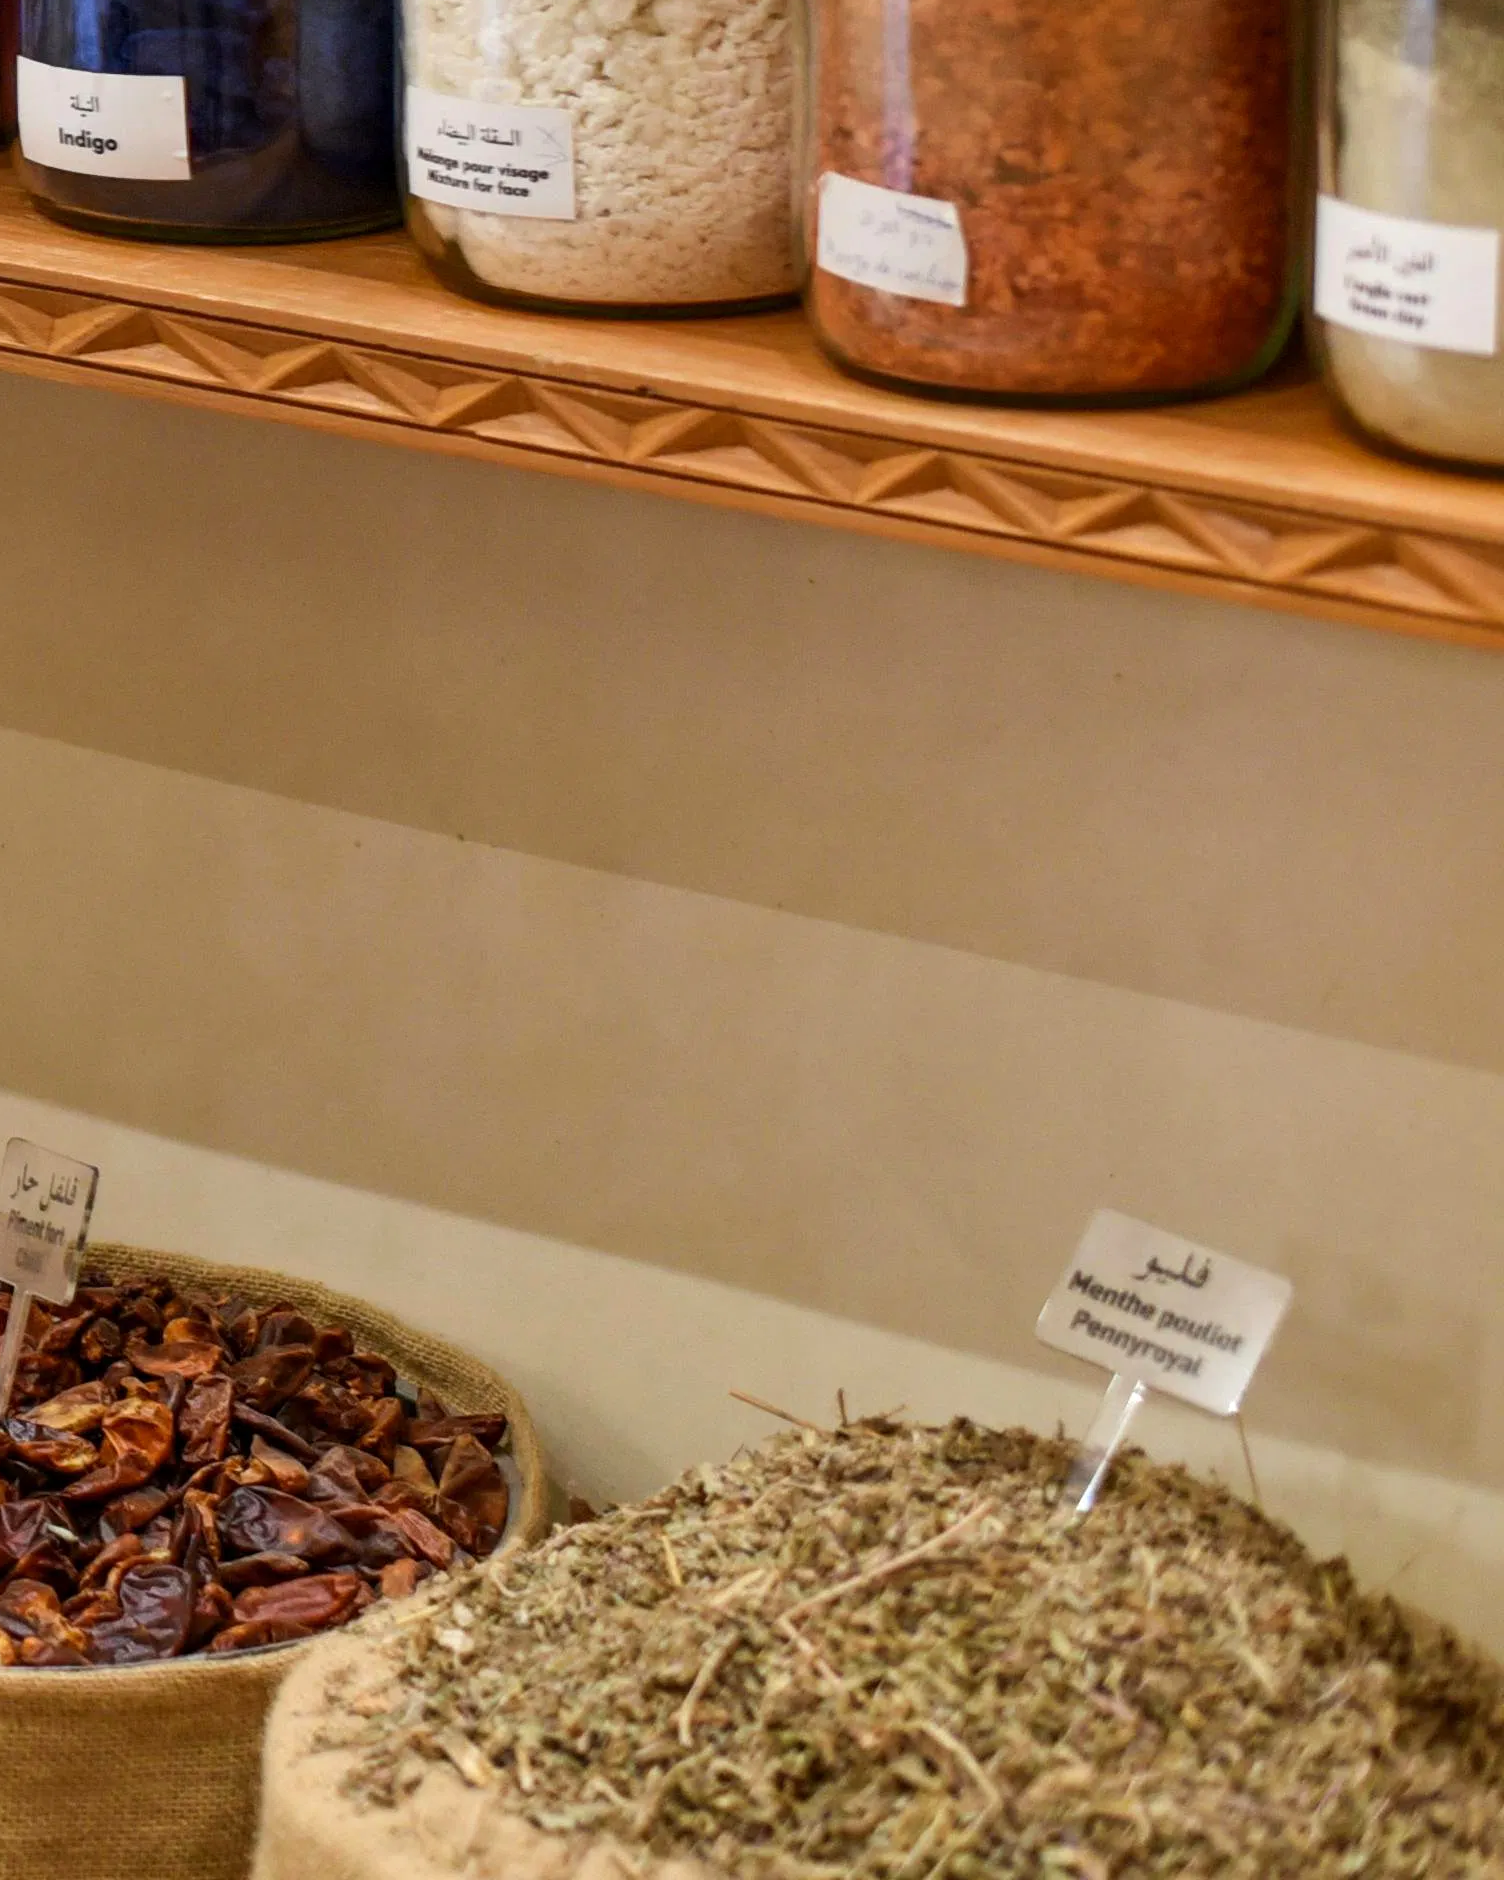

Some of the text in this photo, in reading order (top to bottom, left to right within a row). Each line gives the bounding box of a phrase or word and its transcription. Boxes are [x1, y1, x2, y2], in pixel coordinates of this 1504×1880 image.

[59, 128, 118, 154] Indigo
[427, 170, 530, 198] Mixture for face
[463, 158, 494, 176] pour
[497, 163, 549, 184] visage
[10, 1163, 39, 1200] حار
[1067, 1269, 1156, 1322] Menthe
[1070, 1309, 1203, 1378] Pennyroyal
